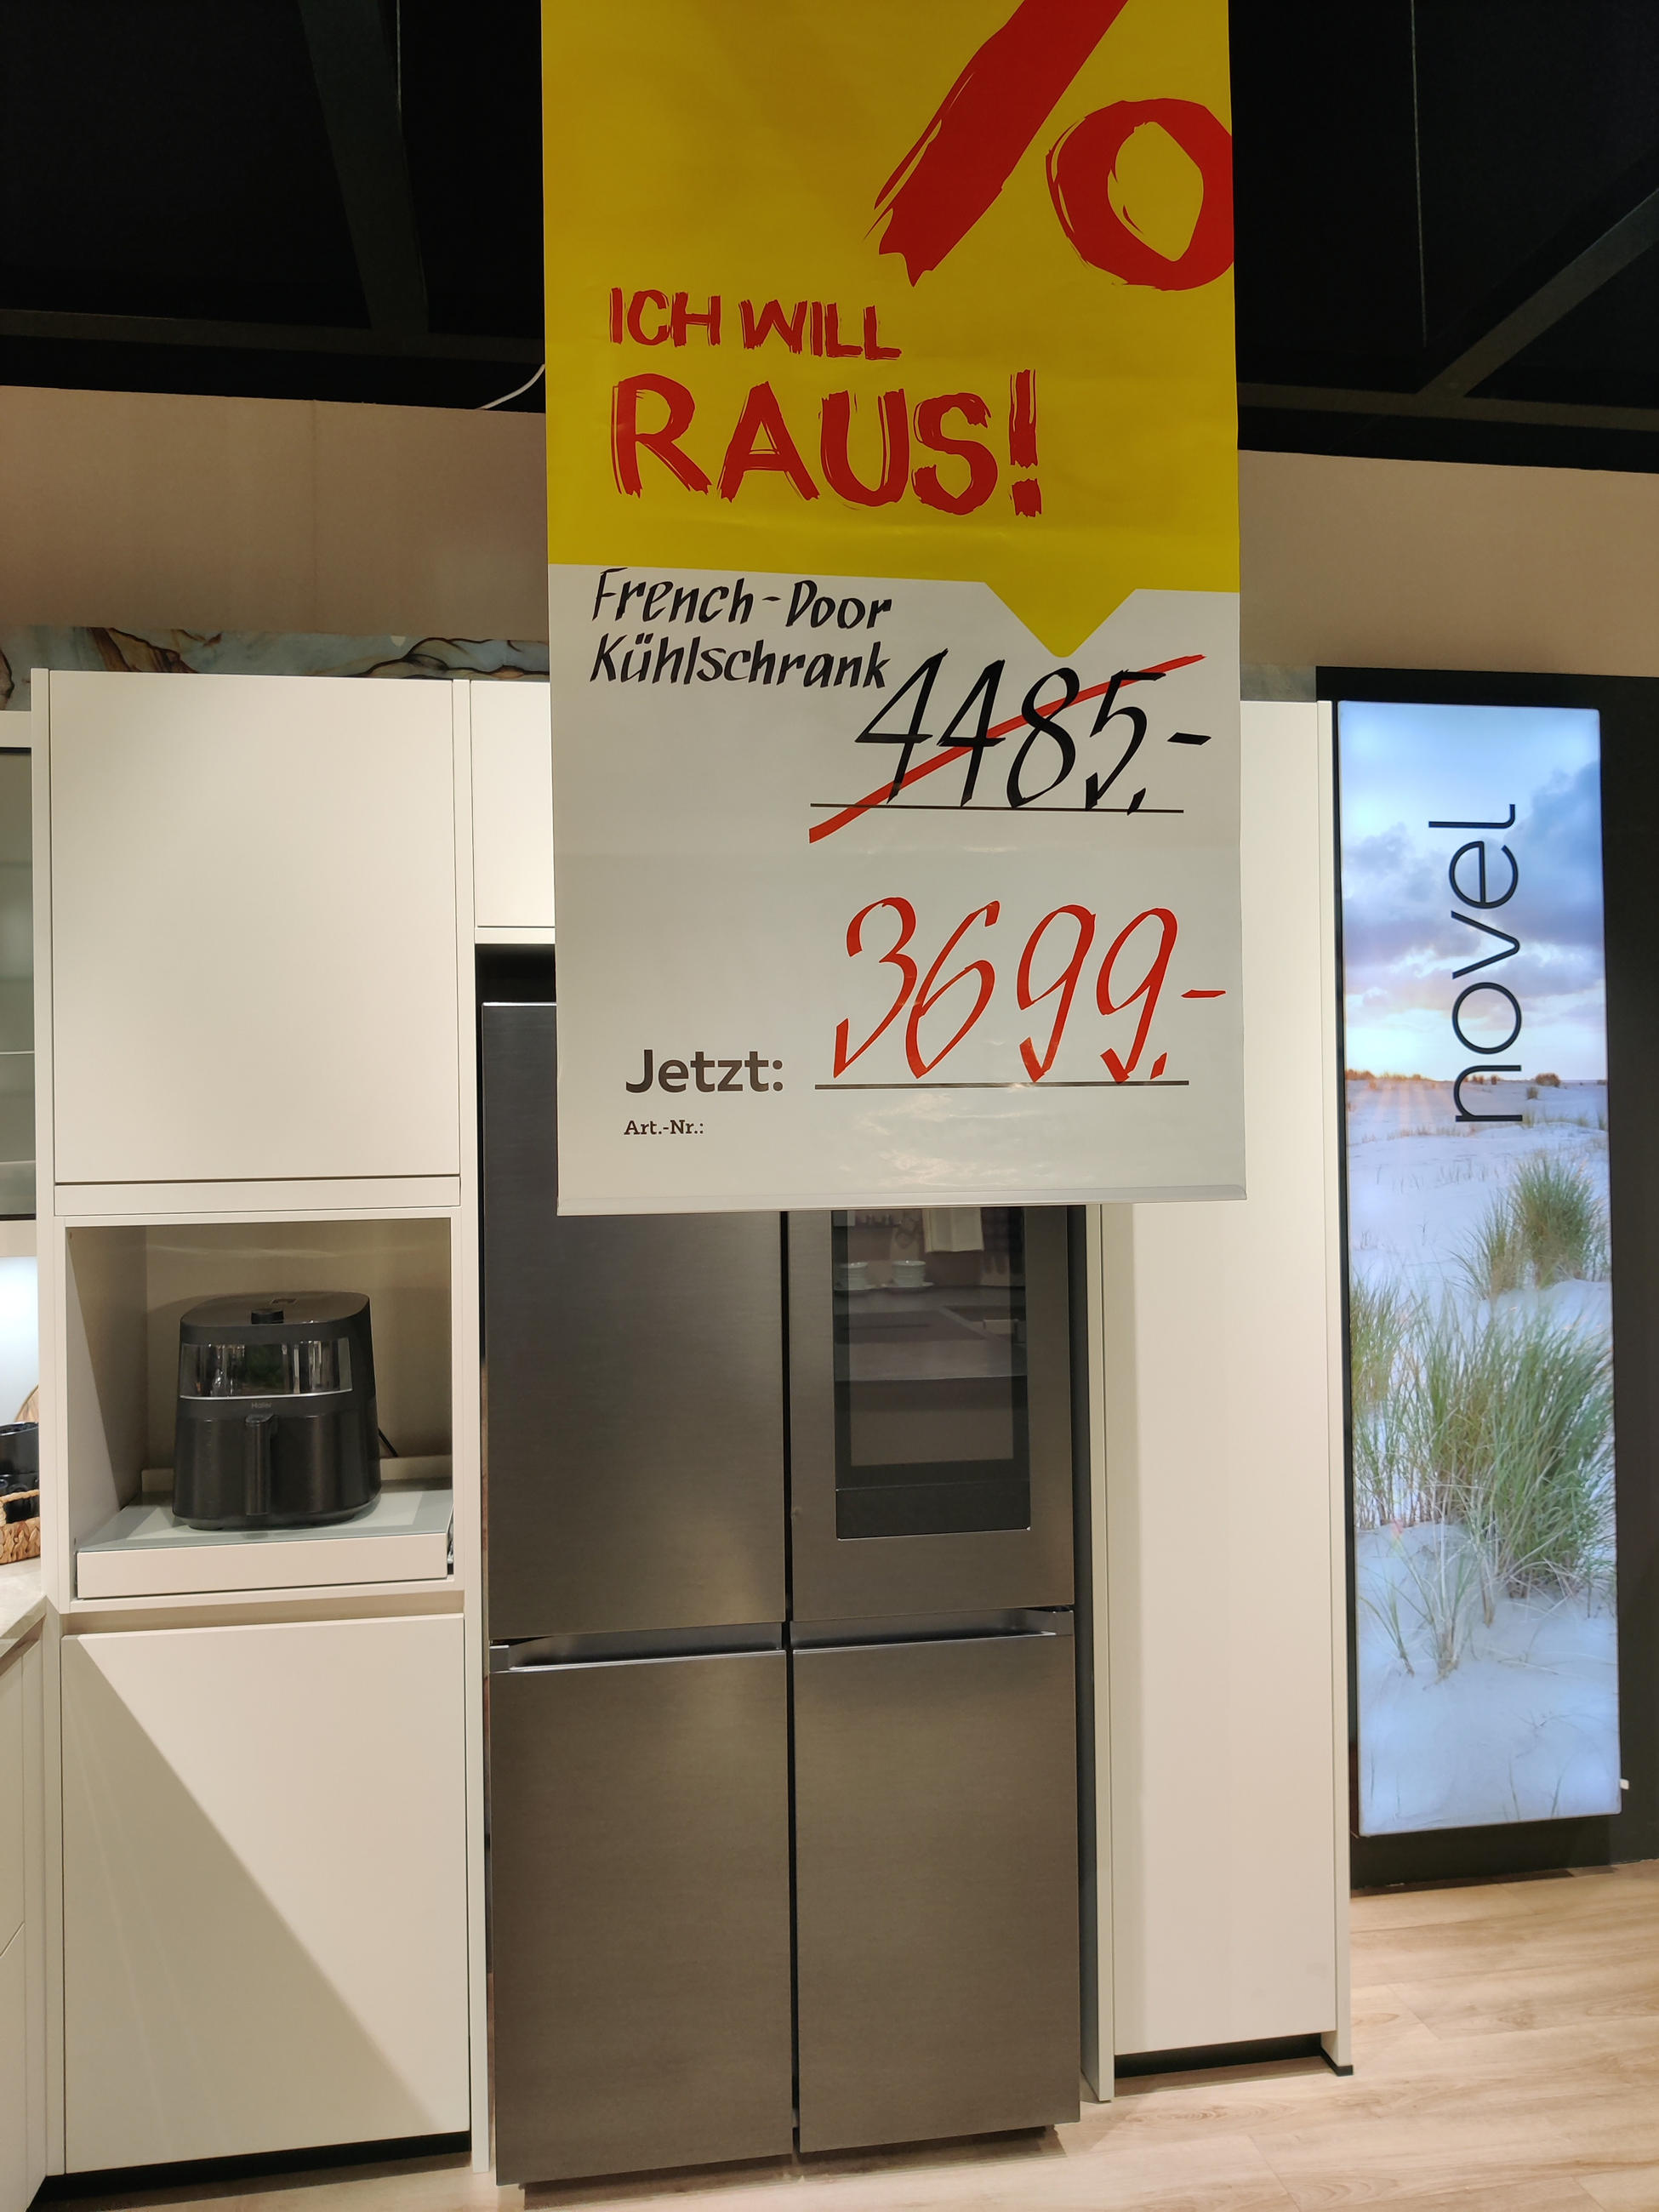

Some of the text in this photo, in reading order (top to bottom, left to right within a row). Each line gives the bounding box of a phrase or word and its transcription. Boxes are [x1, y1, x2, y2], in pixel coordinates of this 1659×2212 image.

[609, 287, 903, 361] ICH WILL
[610, 368, 1042, 517] RAUS!
[591, 567, 892, 630] French-Door
[590, 632, 892, 689] Kühlschrank
[1428, 803, 1524, 1123] novel
[625, 1048, 784, 1093] Jetzt:
[623, 1119, 704, 1136] Art.-Nr.:
